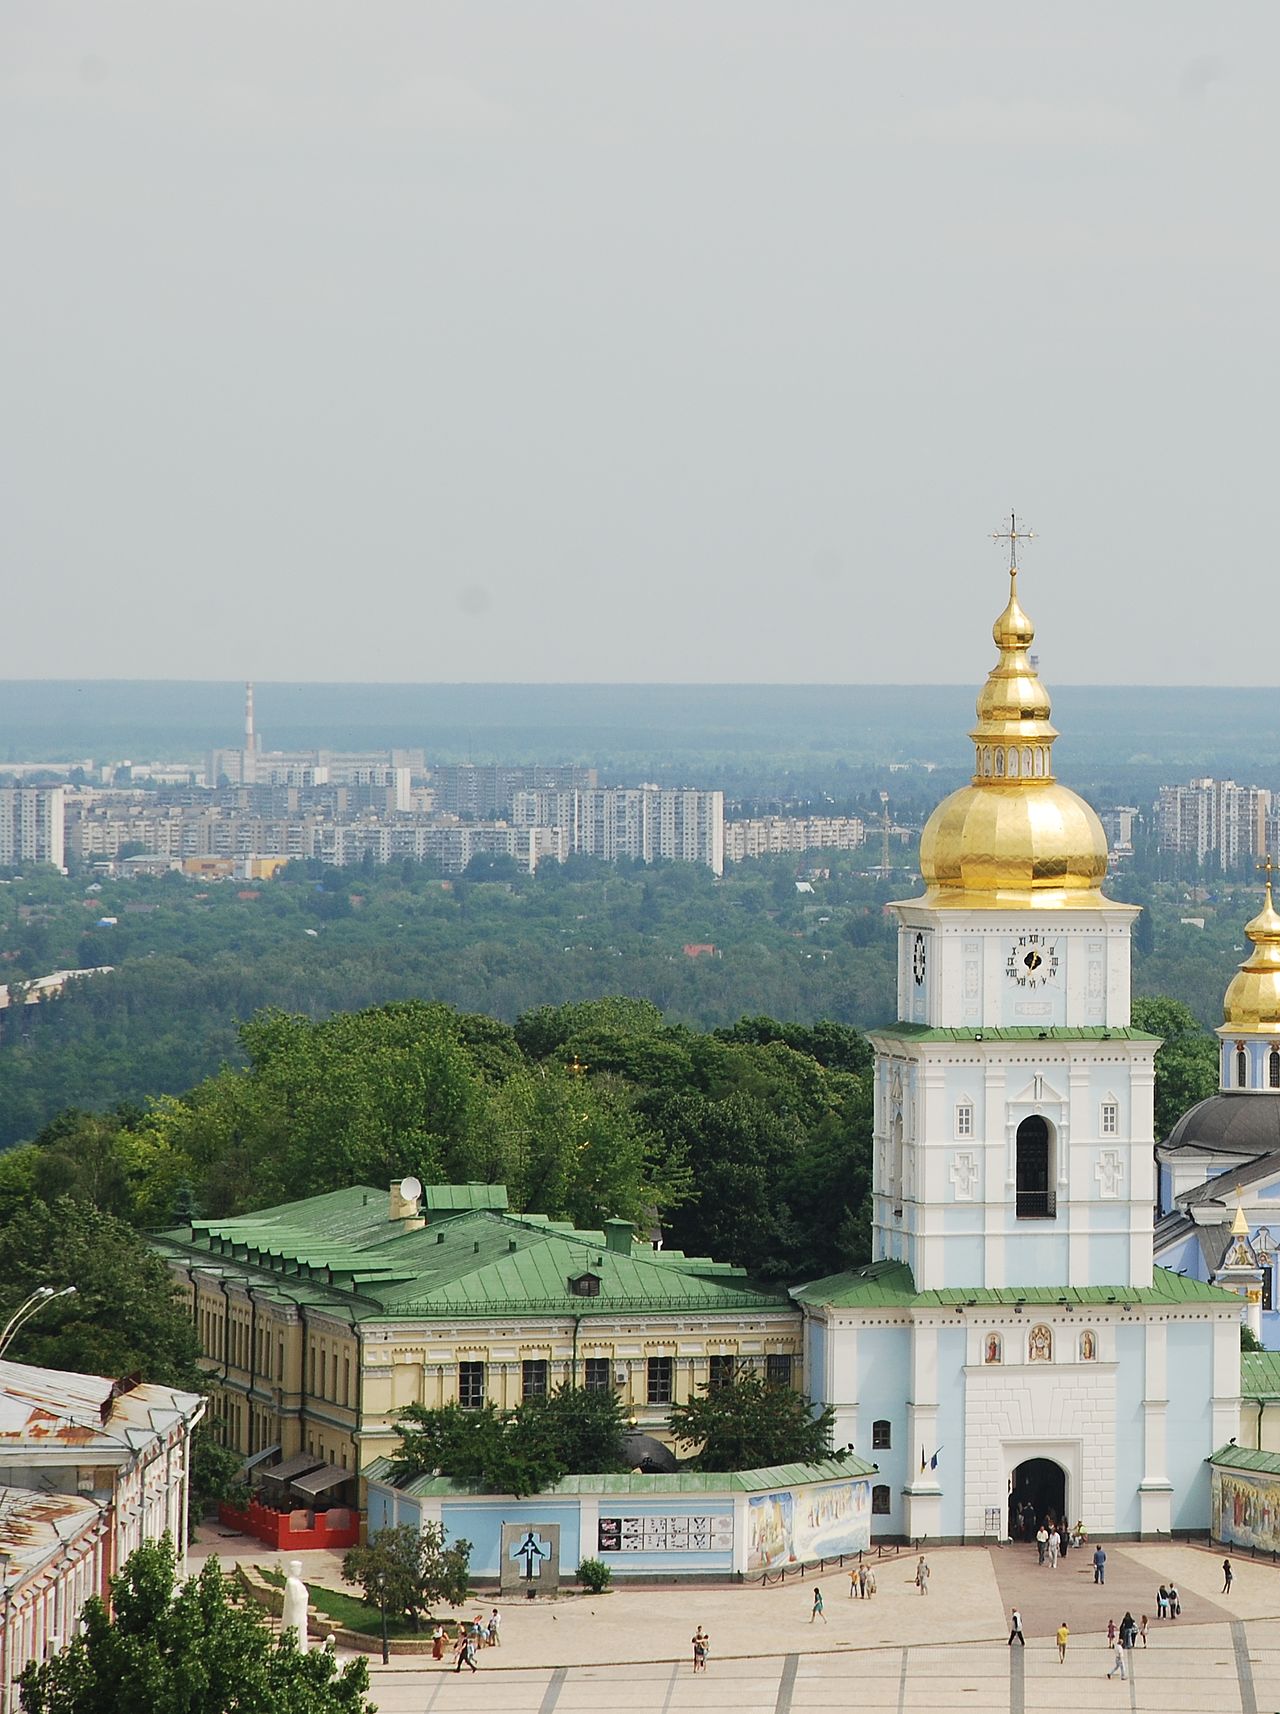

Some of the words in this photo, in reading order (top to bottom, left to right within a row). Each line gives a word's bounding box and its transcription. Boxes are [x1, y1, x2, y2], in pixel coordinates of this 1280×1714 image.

[1019, 937, 1026, 946] XI
[1029, 935, 1038, 943] XII
[1012, 947, 1016, 955] X
[1008, 958, 1014, 966] IX
[1006, 969, 1017, 977] VIII
[1050, 969, 1056, 977] IV
[1029, 980, 1035, 988] VI
